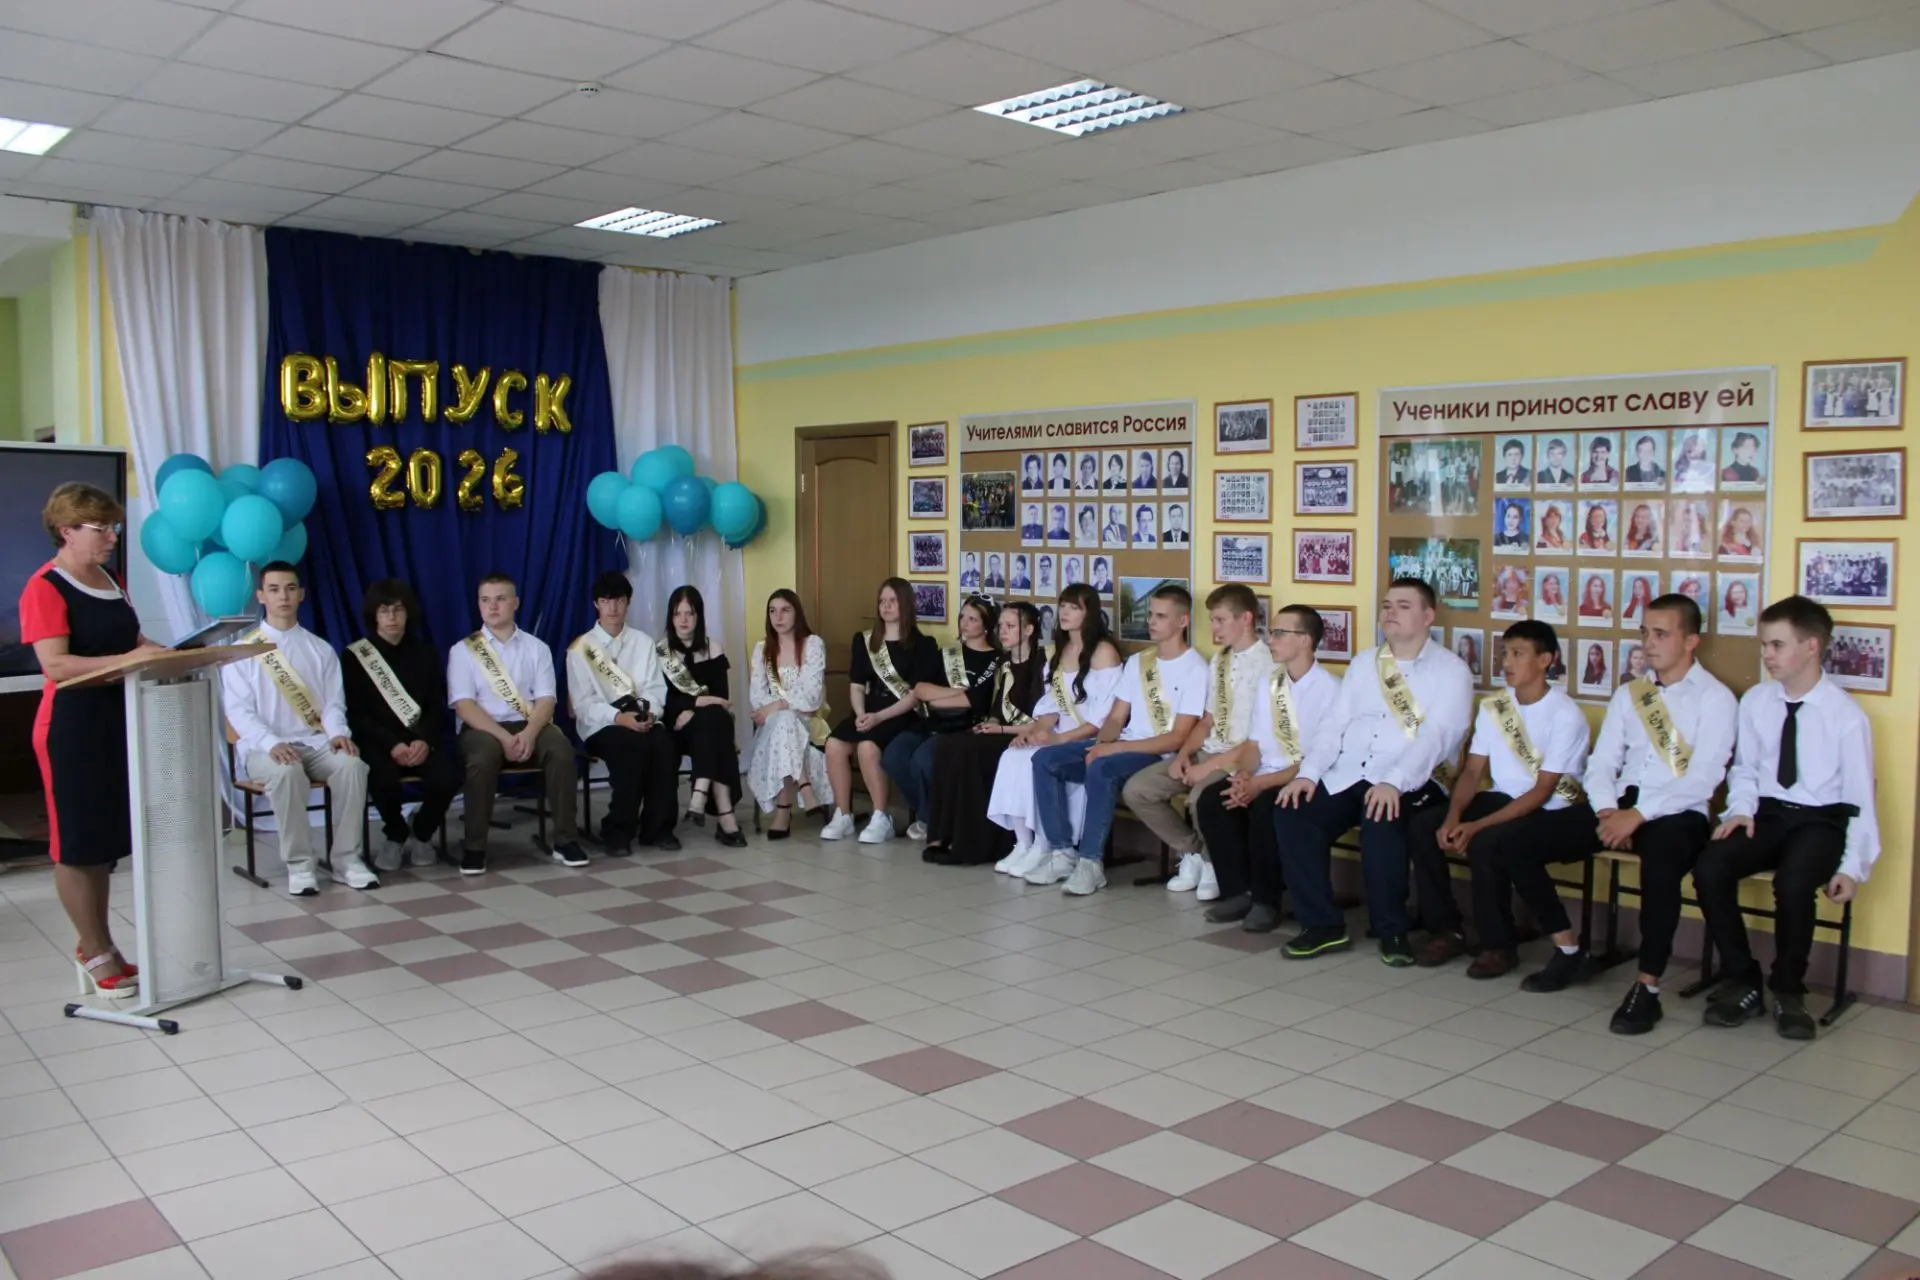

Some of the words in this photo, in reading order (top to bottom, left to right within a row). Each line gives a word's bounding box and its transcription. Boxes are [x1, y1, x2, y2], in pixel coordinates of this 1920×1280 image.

[281, 352, 571, 433] ВЫПУСК
[1393, 401, 1489, 421] Ученики
[1497, 395, 1618, 422] приносят
[1625, 390, 1709, 414] славу
[1717, 382, 1754, 407] ей
[966, 424, 1042, 441] Учителями
[1046, 420, 1118, 437] славится
[1123, 415, 1187, 433] Россия
[366, 447, 524, 511] 2026
